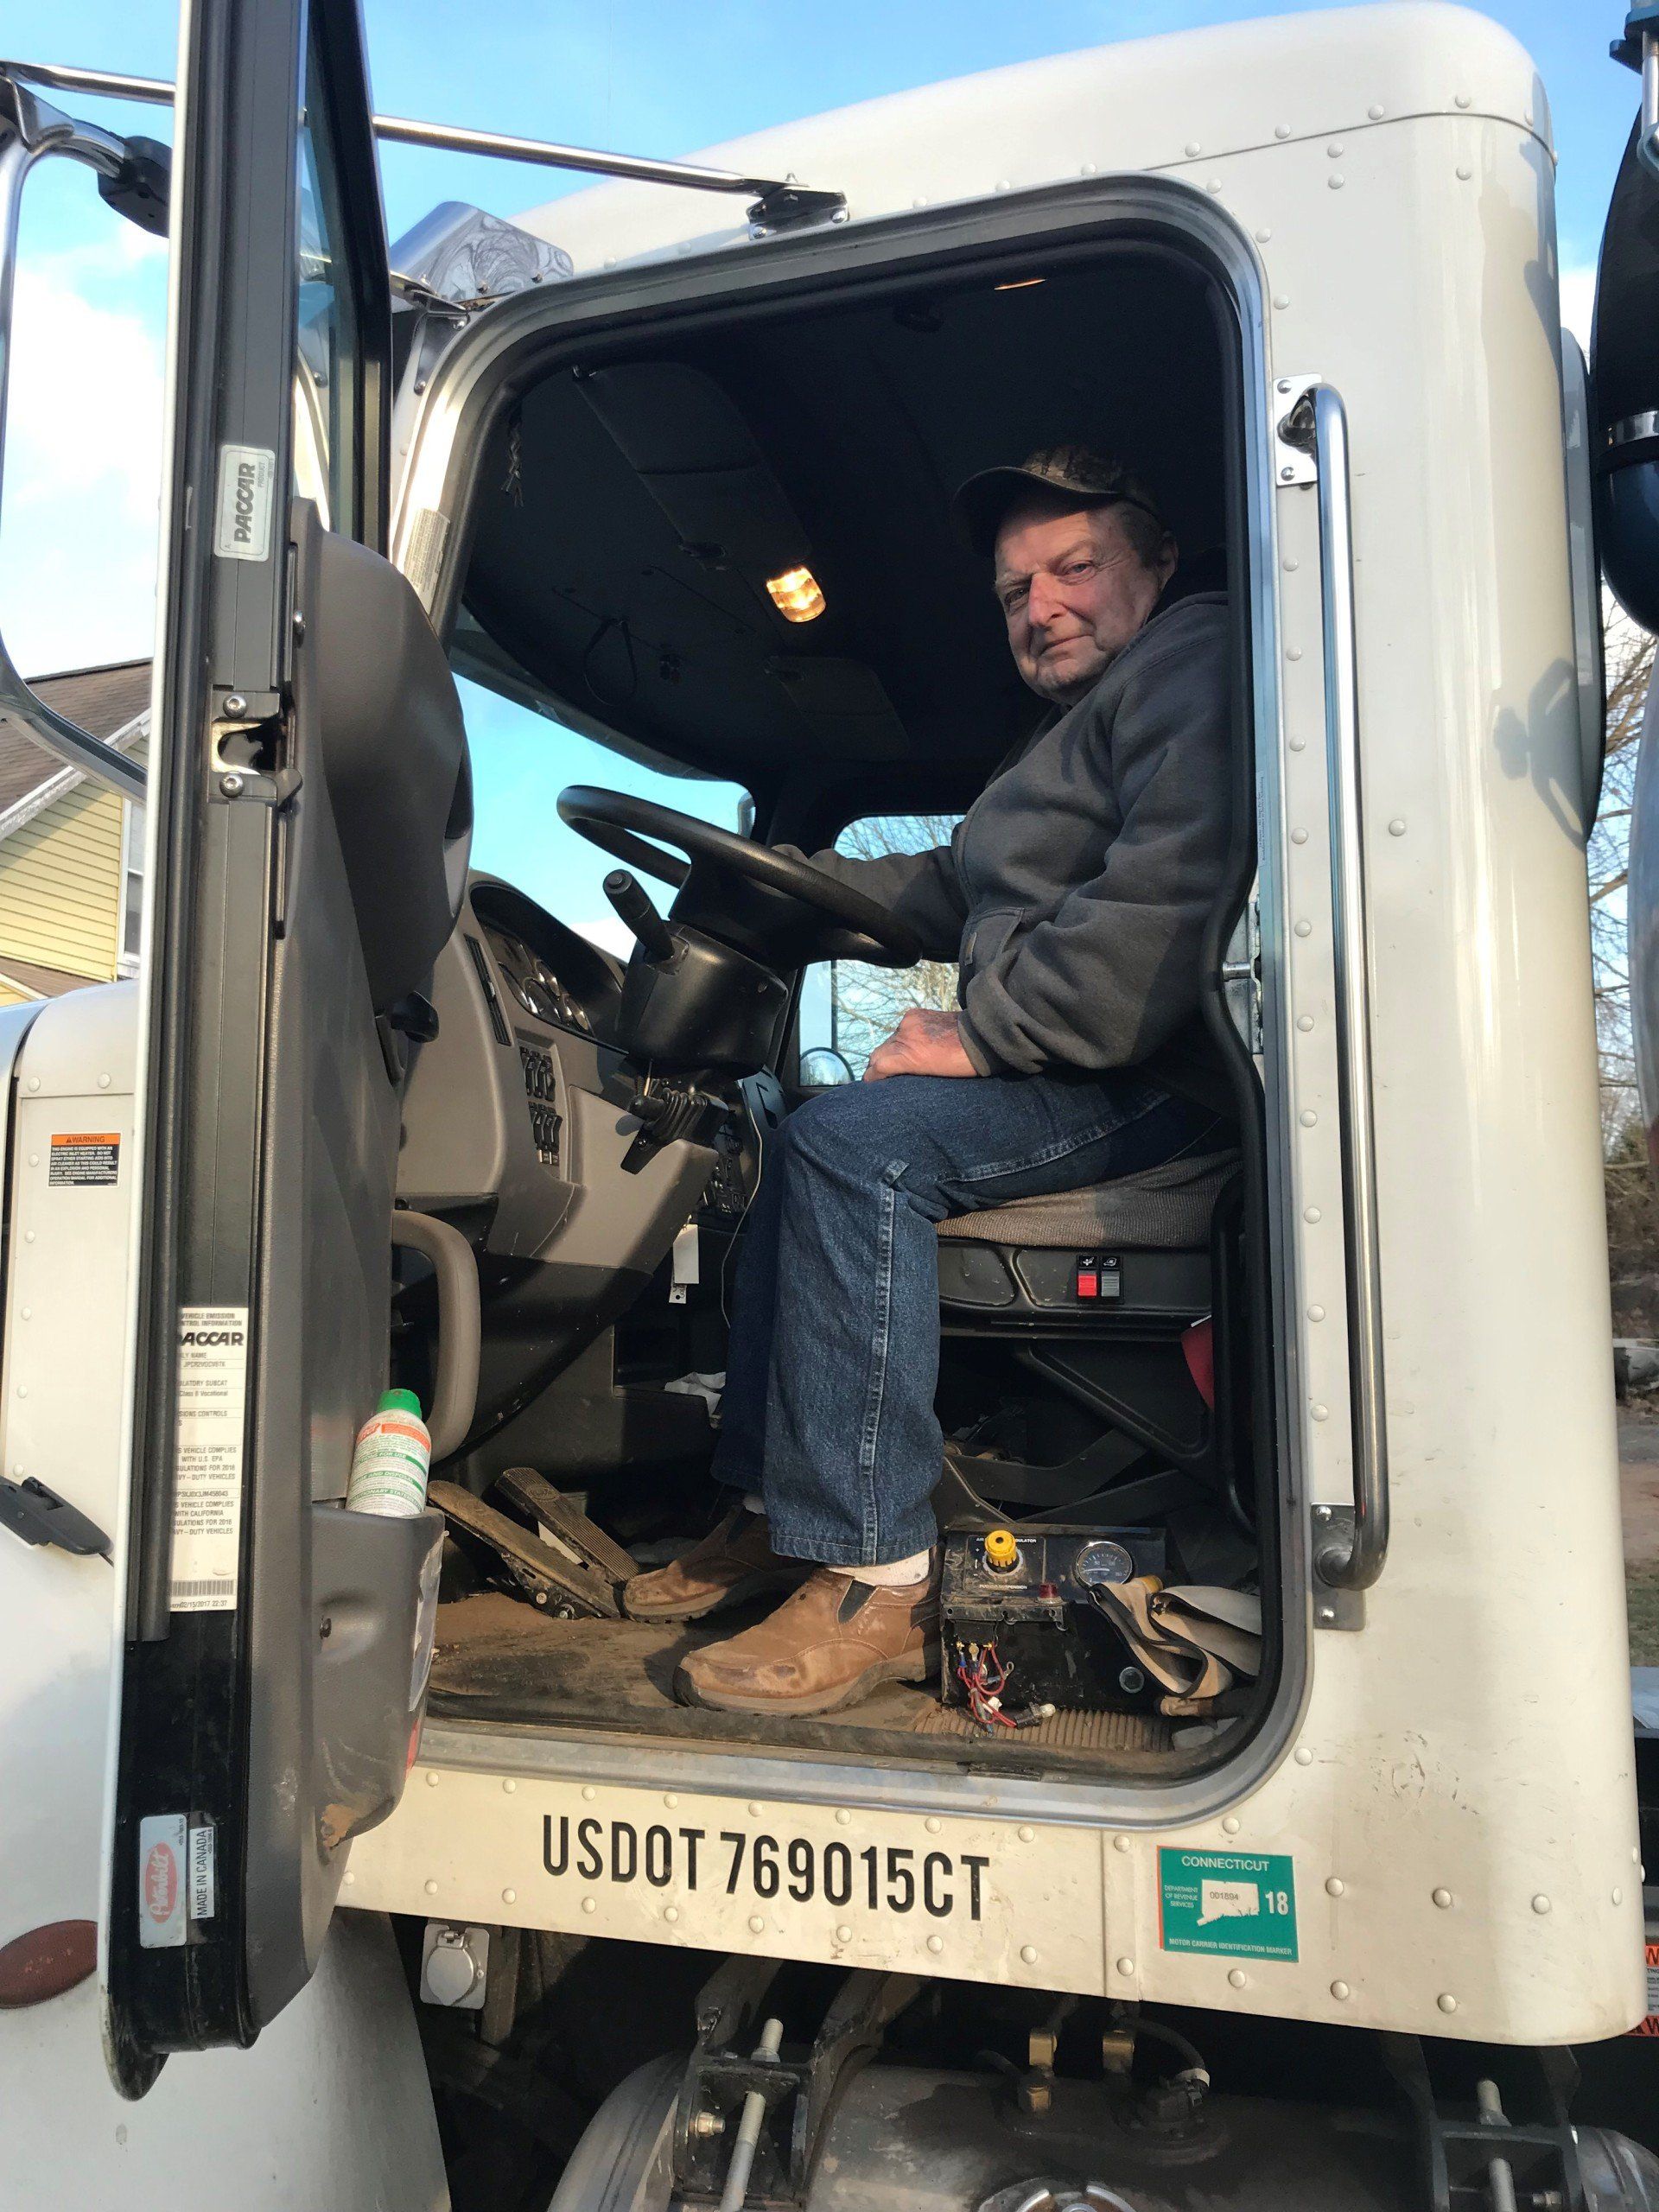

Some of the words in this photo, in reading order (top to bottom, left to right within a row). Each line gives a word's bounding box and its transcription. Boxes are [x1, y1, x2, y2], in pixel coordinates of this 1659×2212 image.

[234, 463, 255, 543] PACCAR
[180, 1332, 244, 1346] ACCAR
[196, 1830, 207, 1873] CANADA
[543, 1814, 705, 1891] USDOT
[720, 1831, 990, 1921] 769015CT
[1181, 1856, 1270, 1872] CONNECTICUT
[149, 1847, 169, 1915] Peterbilt
[197, 1874, 207, 1887] IN
[1164, 1885, 1198, 1893] DEPARTMENT
[197, 1889, 207, 1916] MADE
[1210, 1891, 1239, 1901] 001894
[1265, 1891, 1289, 1916] 18
[1169, 1938, 1191, 1947] MOTOR
[1192, 1940, 1217, 1949] CARRIER
[1218, 1941, 1265, 1953] IDENTIFICATION
[1266, 1946, 1293, 1955] MARKER
